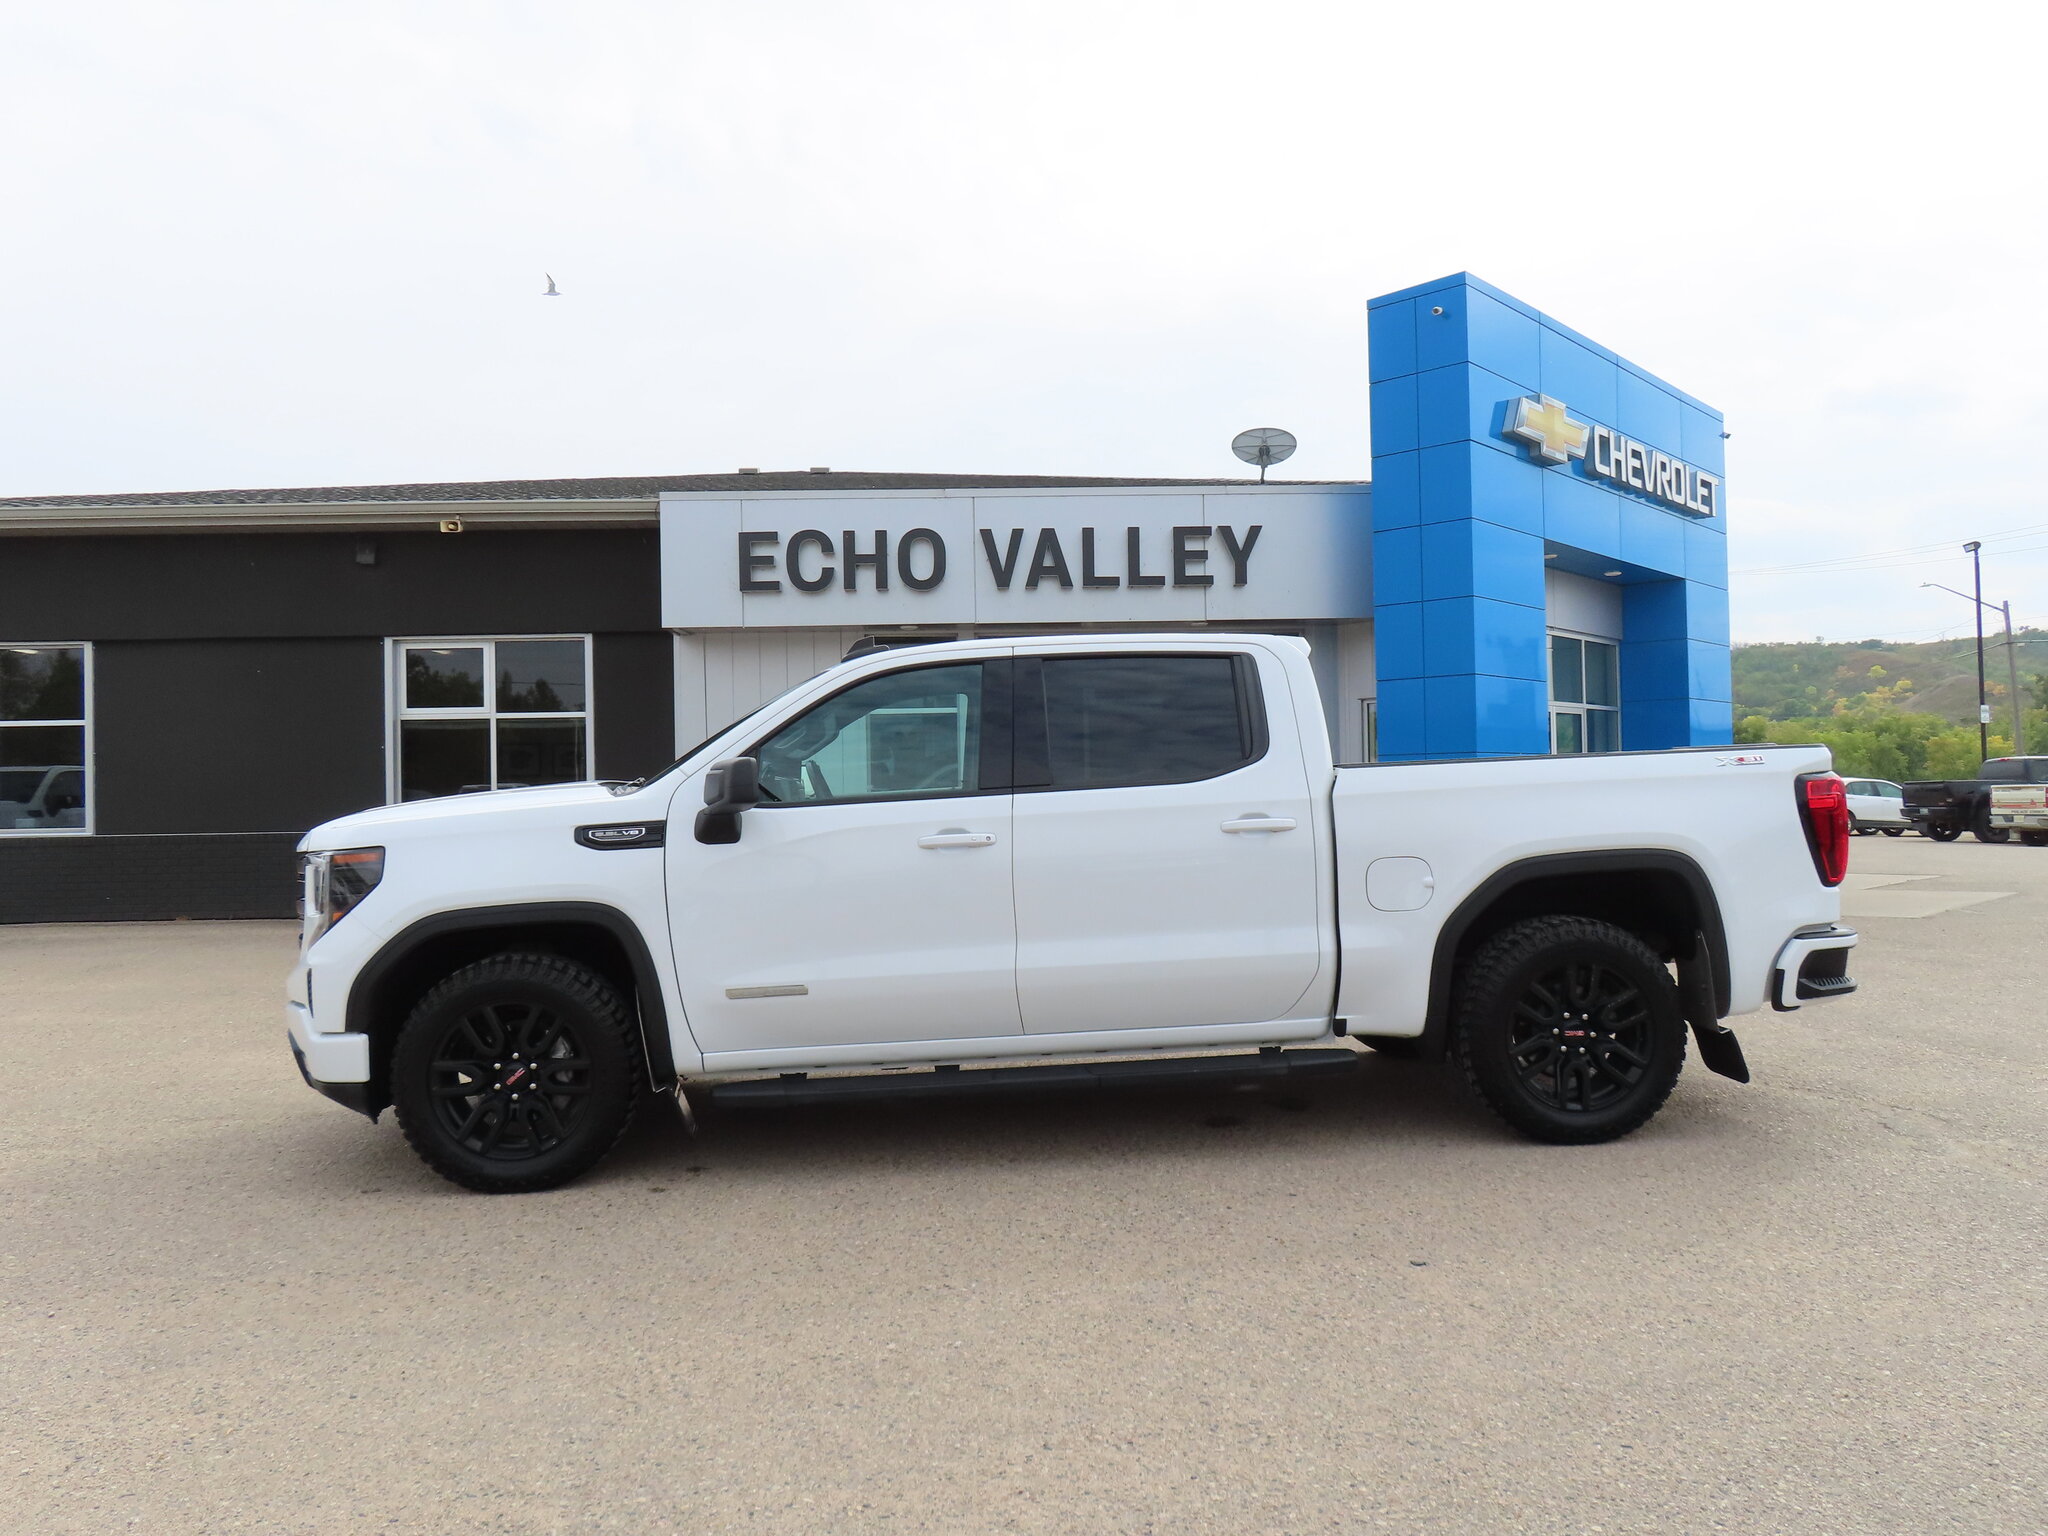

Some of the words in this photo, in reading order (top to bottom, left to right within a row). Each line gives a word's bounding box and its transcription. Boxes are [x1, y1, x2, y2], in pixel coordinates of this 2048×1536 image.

[1591, 424, 1719, 517] CHEVROLET
[738, 527, 947, 592] ECHO
[979, 525, 1262, 590] VALLEY
